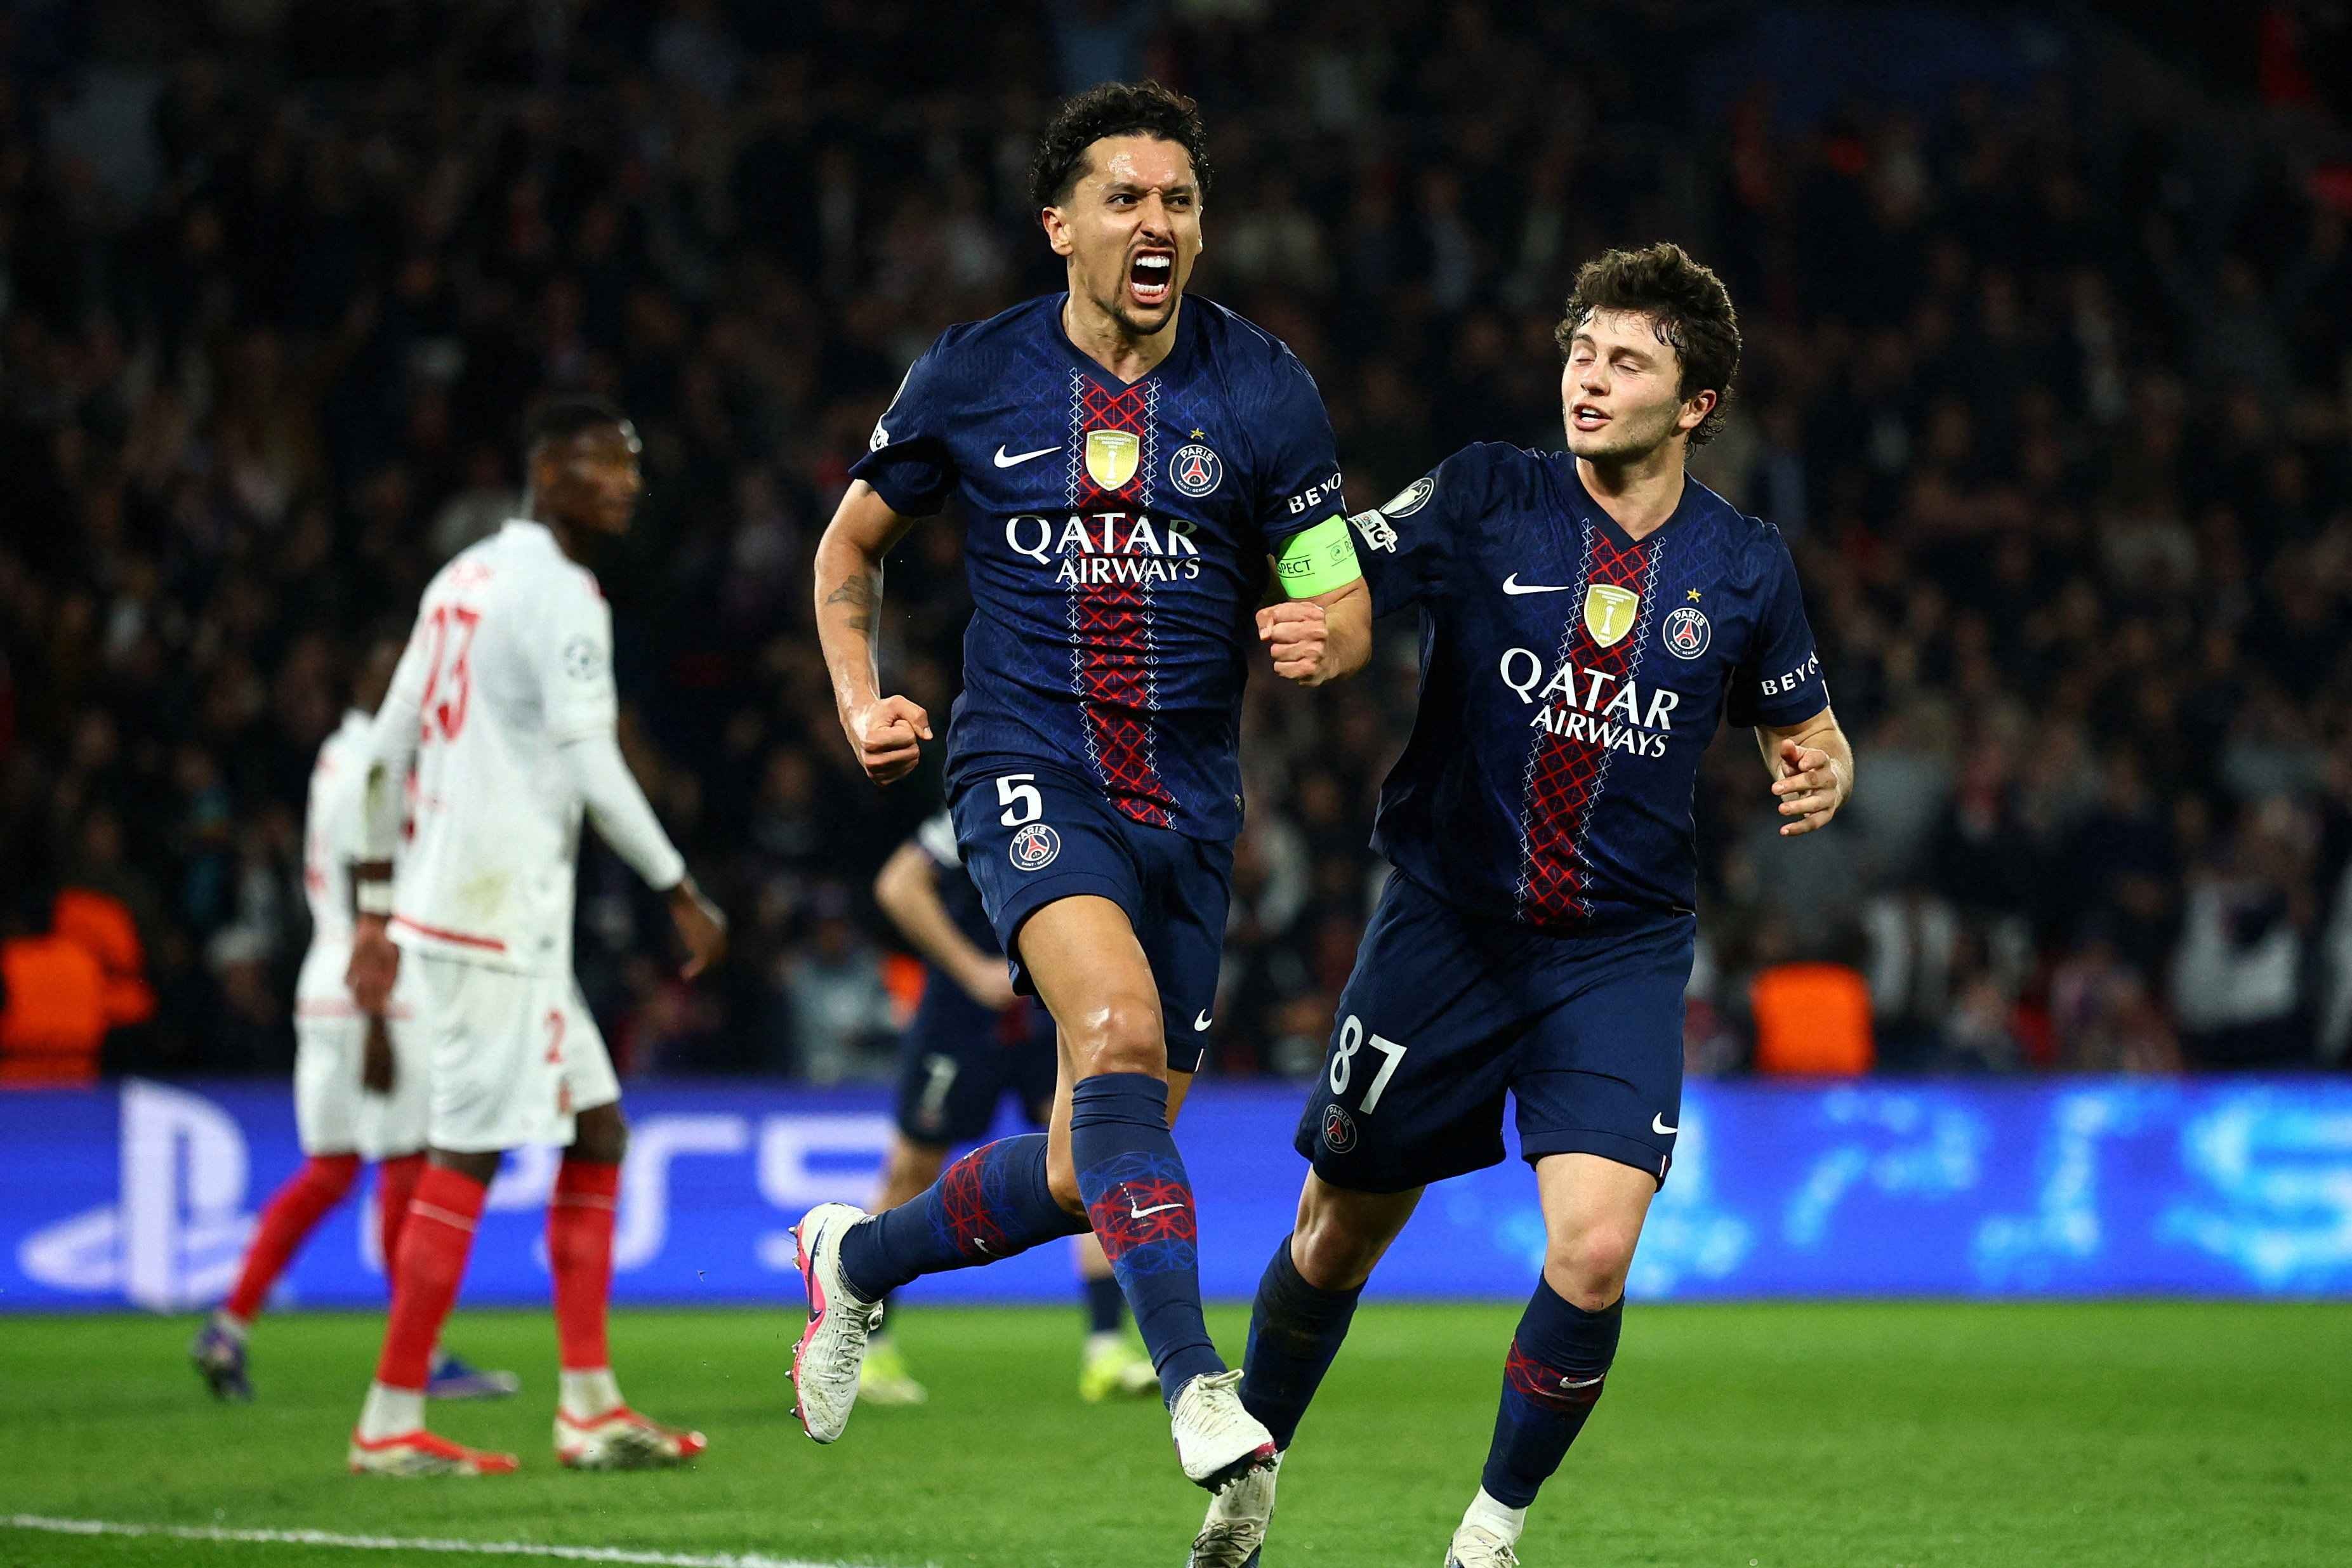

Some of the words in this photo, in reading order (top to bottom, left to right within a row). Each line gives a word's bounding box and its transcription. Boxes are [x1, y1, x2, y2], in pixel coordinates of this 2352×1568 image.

[1180, 447, 1214, 461] PARIS
[1006, 512, 1199, 565] QATAR
[1055, 557, 1201, 584] AIRWAYS
[1674, 610, 1705, 627] PARIS
[1500, 647, 1680, 731] QATAR
[1529, 704, 1670, 758] AIRWAYS
[996, 774, 1042, 826] 5
[1014, 826, 1047, 844] PARIS
[1330, 1015, 1408, 1115] 87
[1329, 1106, 1351, 1126] PARIS
